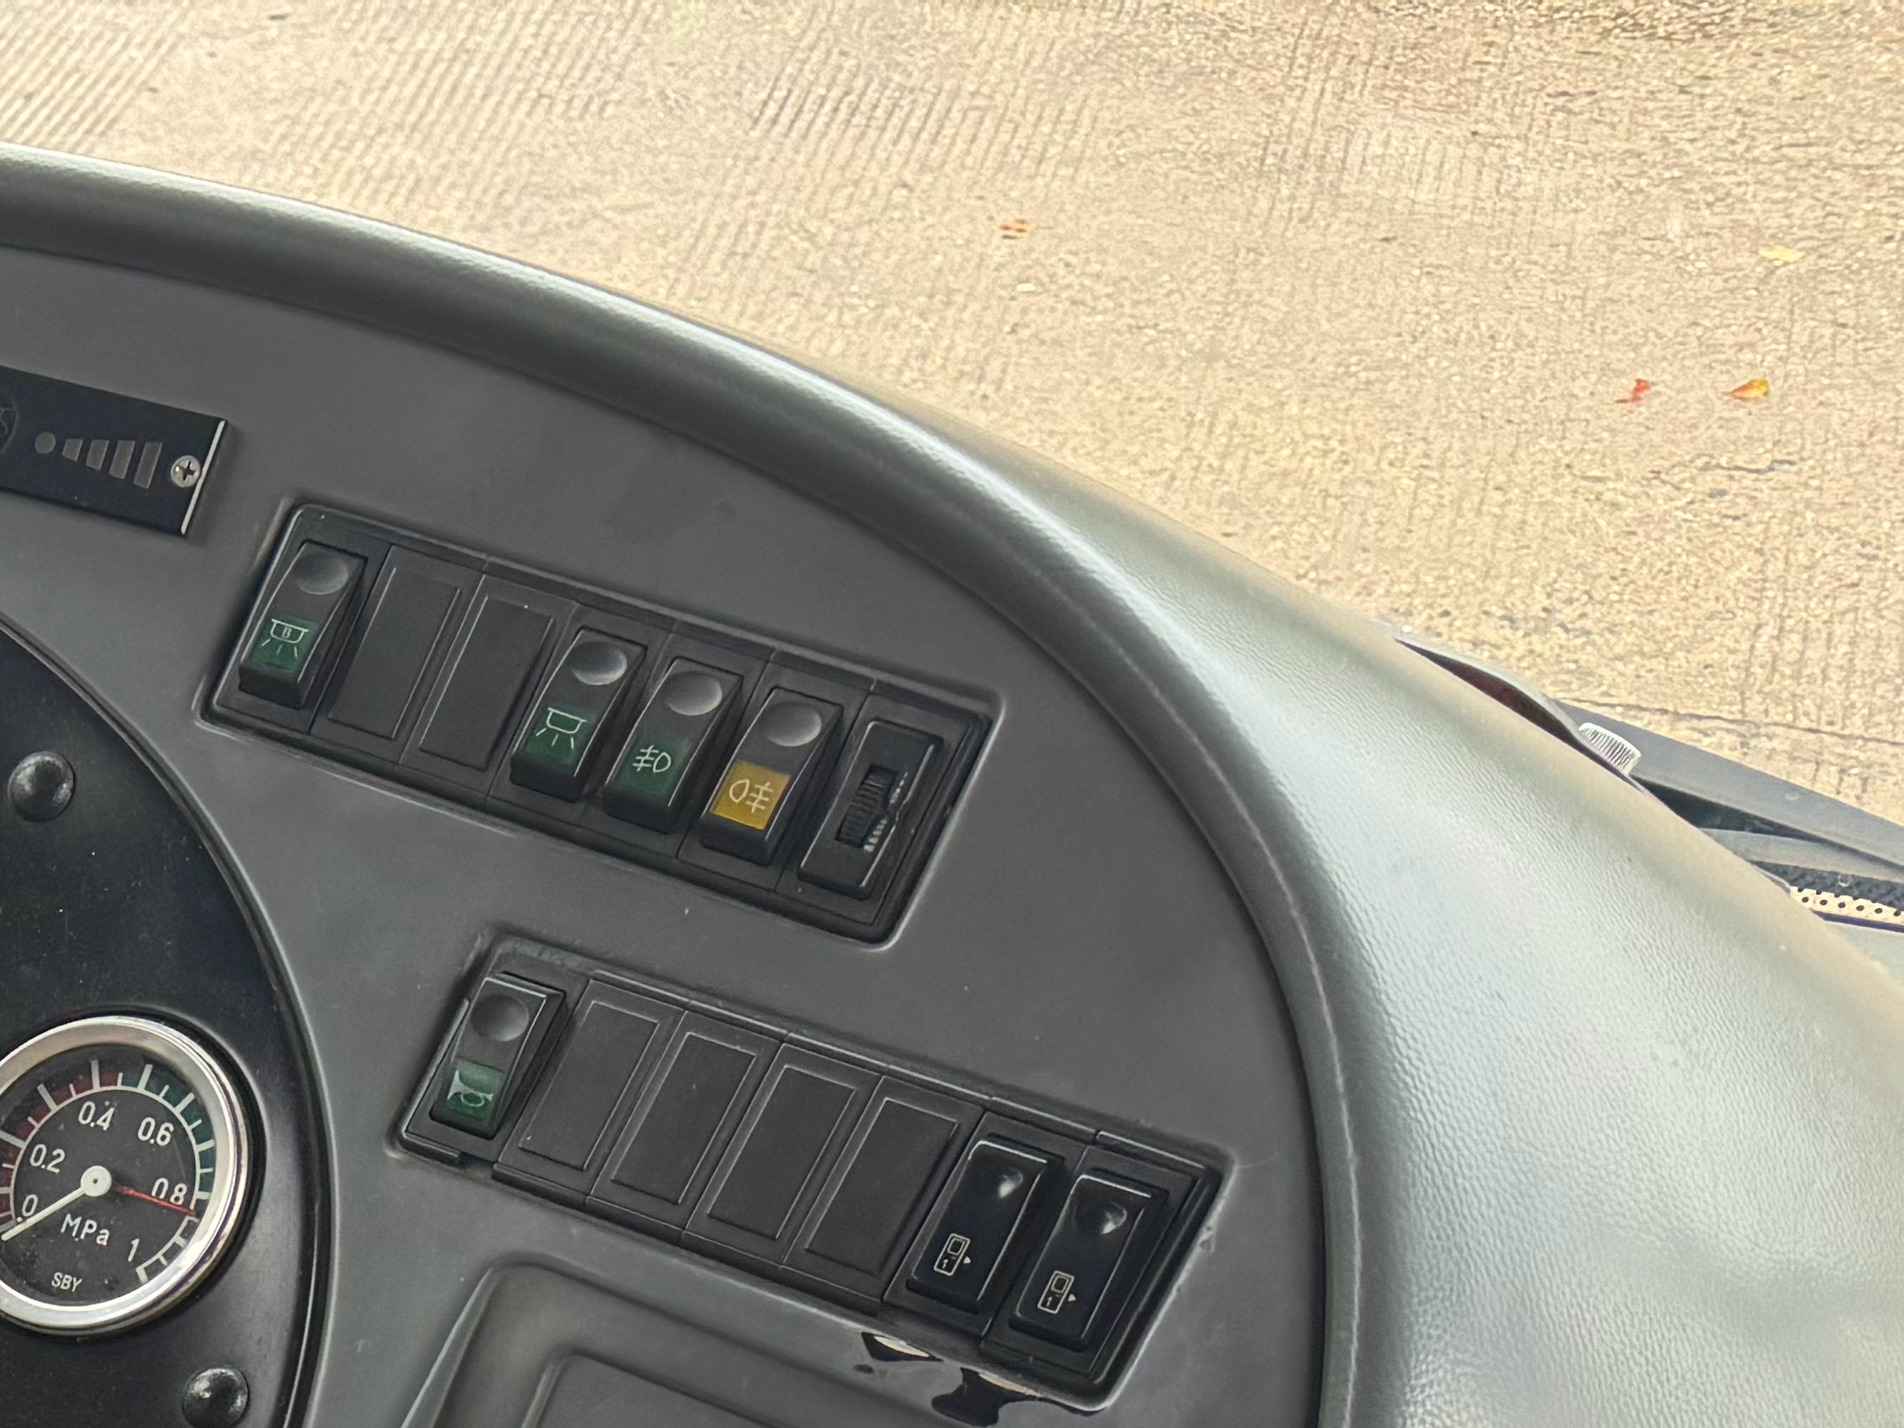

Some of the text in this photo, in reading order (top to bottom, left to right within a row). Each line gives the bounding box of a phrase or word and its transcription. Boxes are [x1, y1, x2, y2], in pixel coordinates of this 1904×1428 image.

[78, 1102, 113, 1131] 0.4
[137, 1117, 175, 1147] 0.6
[29, 1143, 66, 1174] 0.2
[60, 1214, 110, 1246] MPa
[128, 1238, 140, 1262] 1
[51, 1272, 83, 1292] SBY
